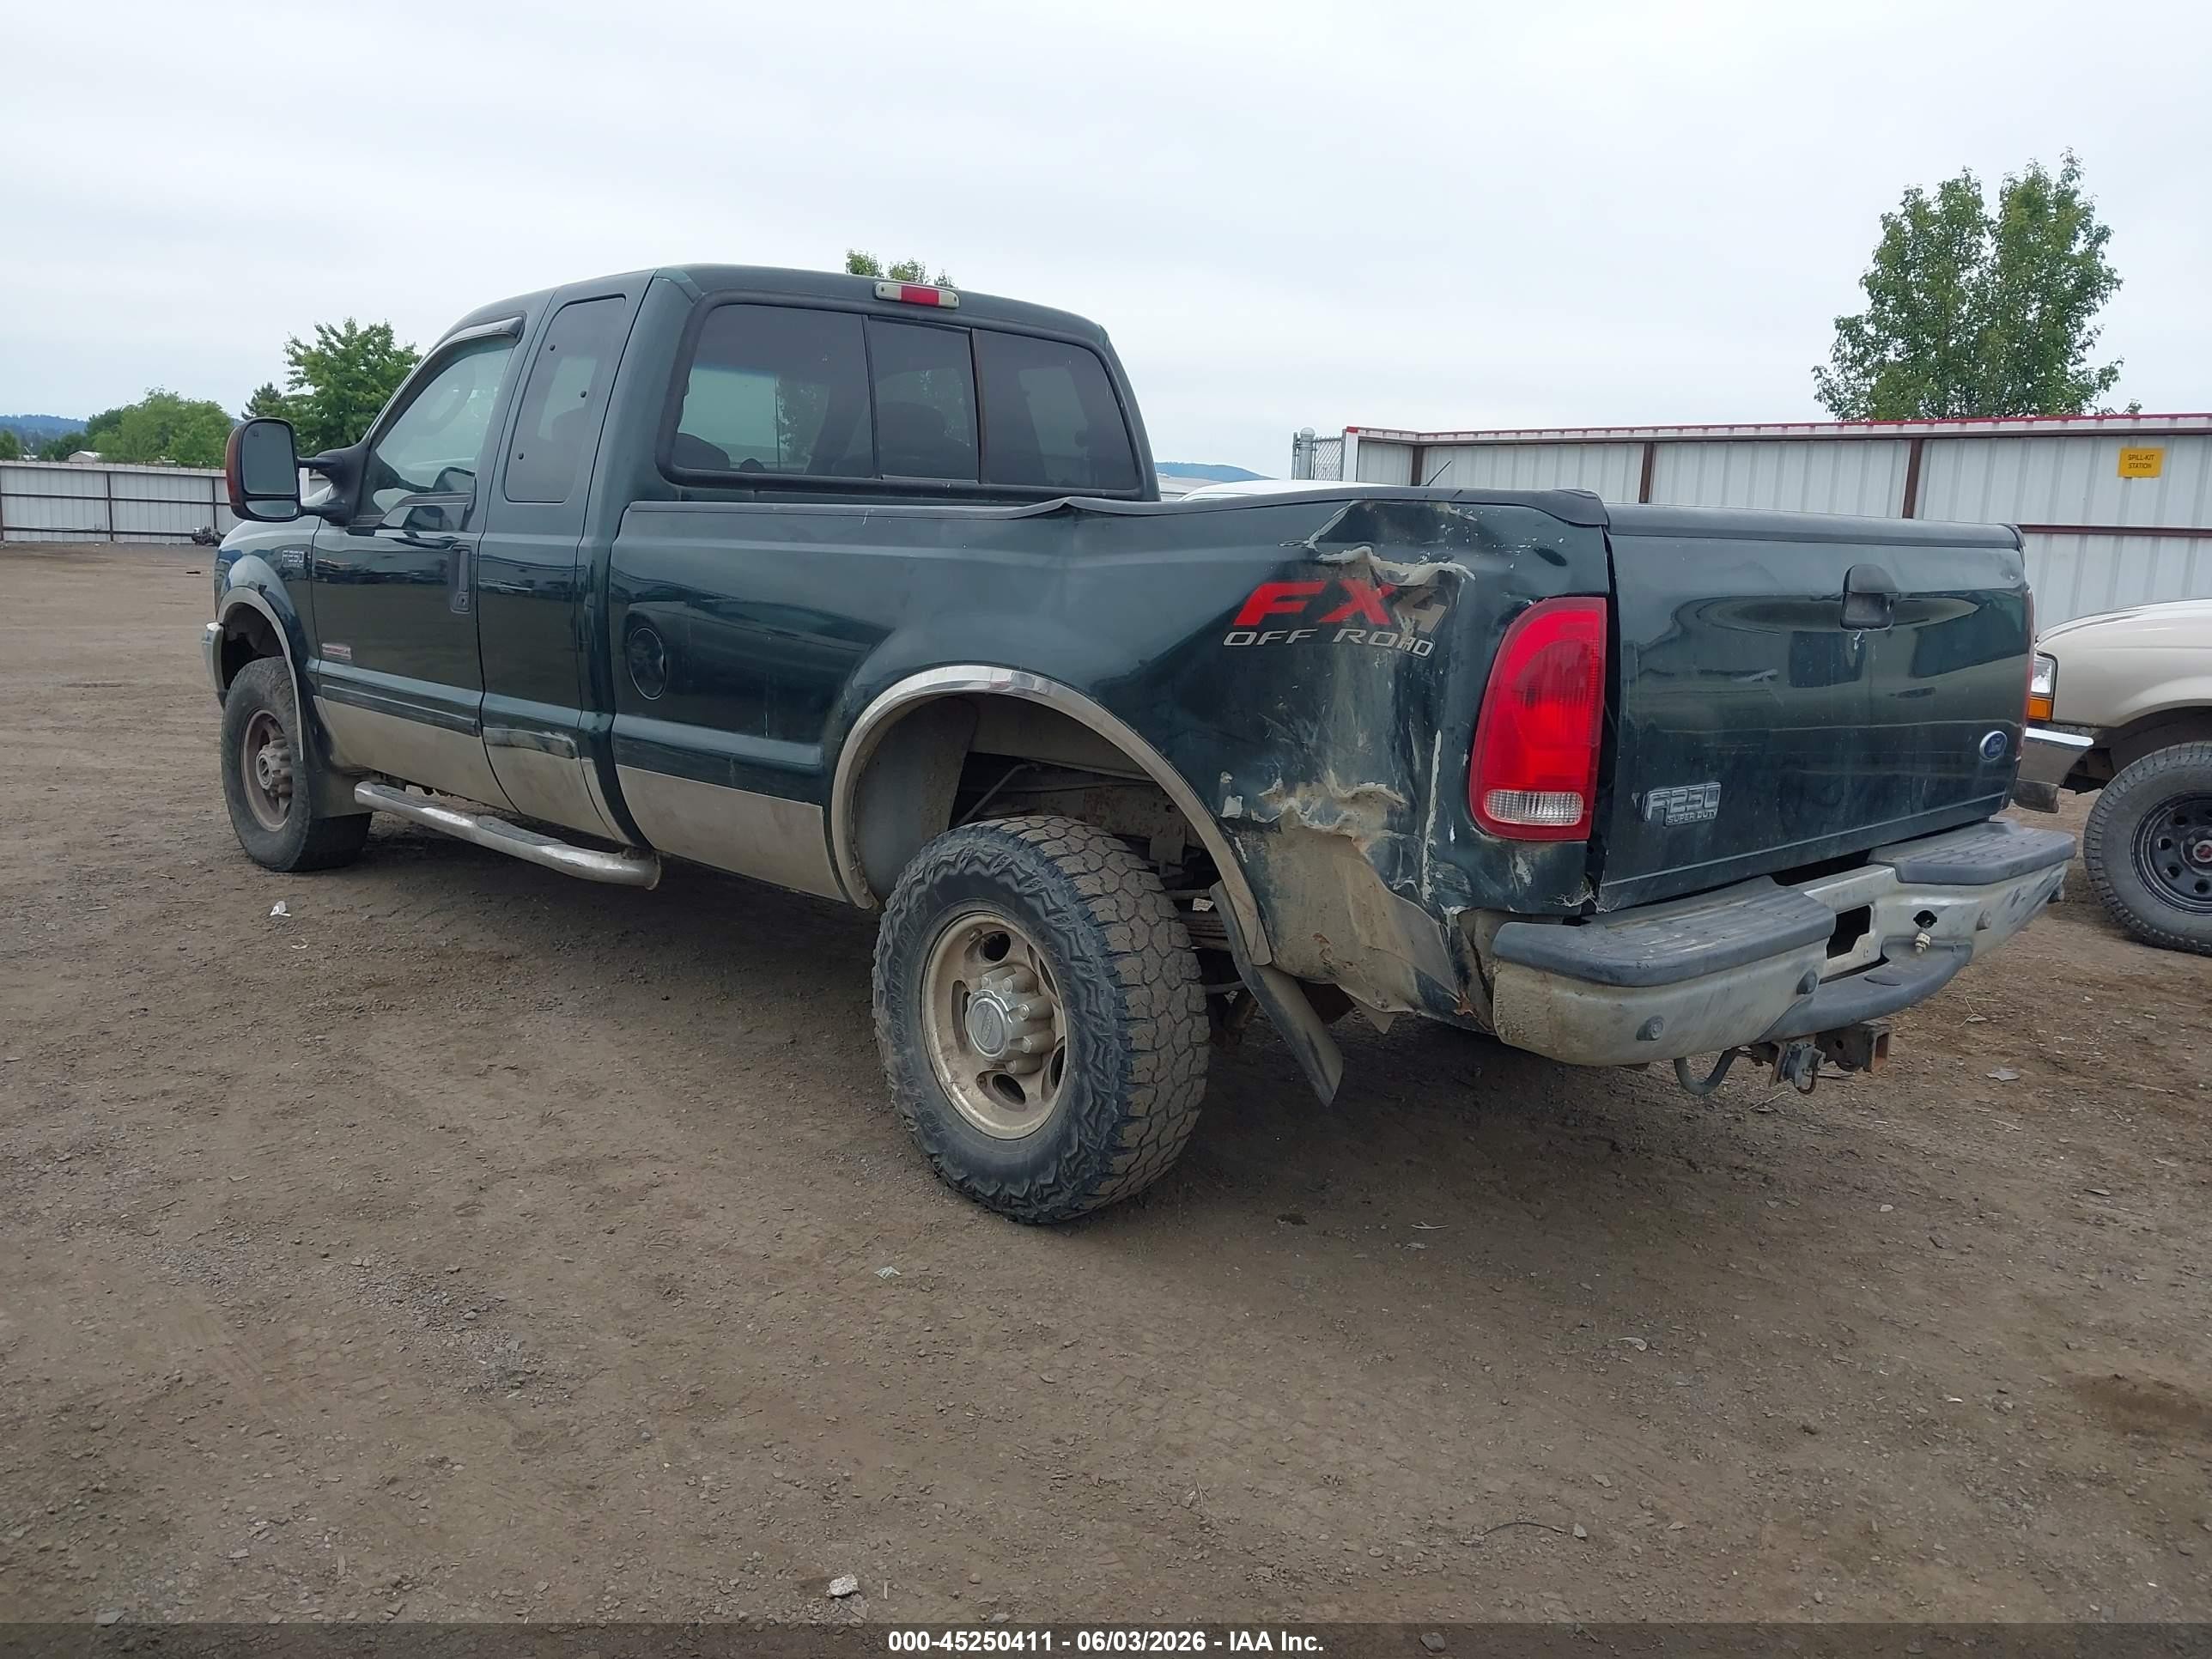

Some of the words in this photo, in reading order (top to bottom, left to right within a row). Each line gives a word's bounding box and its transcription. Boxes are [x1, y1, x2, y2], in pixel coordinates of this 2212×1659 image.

[1223, 628, 1318, 646] OFF
[1332, 629, 1434, 657] ROAD
[1667, 812, 1694, 823] SUPER
[1697, 810, 1717, 818] DUTY
